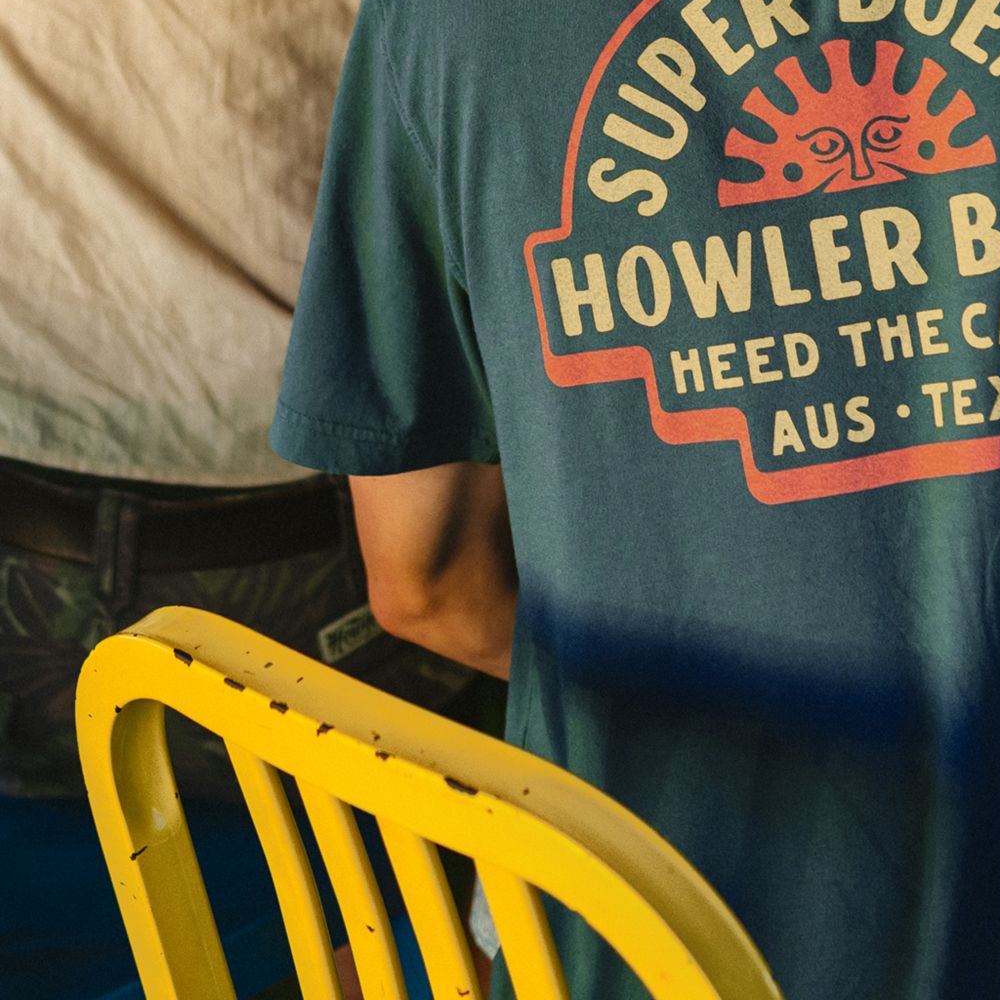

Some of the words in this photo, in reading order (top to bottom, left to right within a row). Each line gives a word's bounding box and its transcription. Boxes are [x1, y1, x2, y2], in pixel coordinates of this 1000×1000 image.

[550, 206, 929, 337] HOWLER
[669, 332, 820, 395] HEED
[837, 308, 950, 368] THE
[772, 395, 876, 457] AUS
